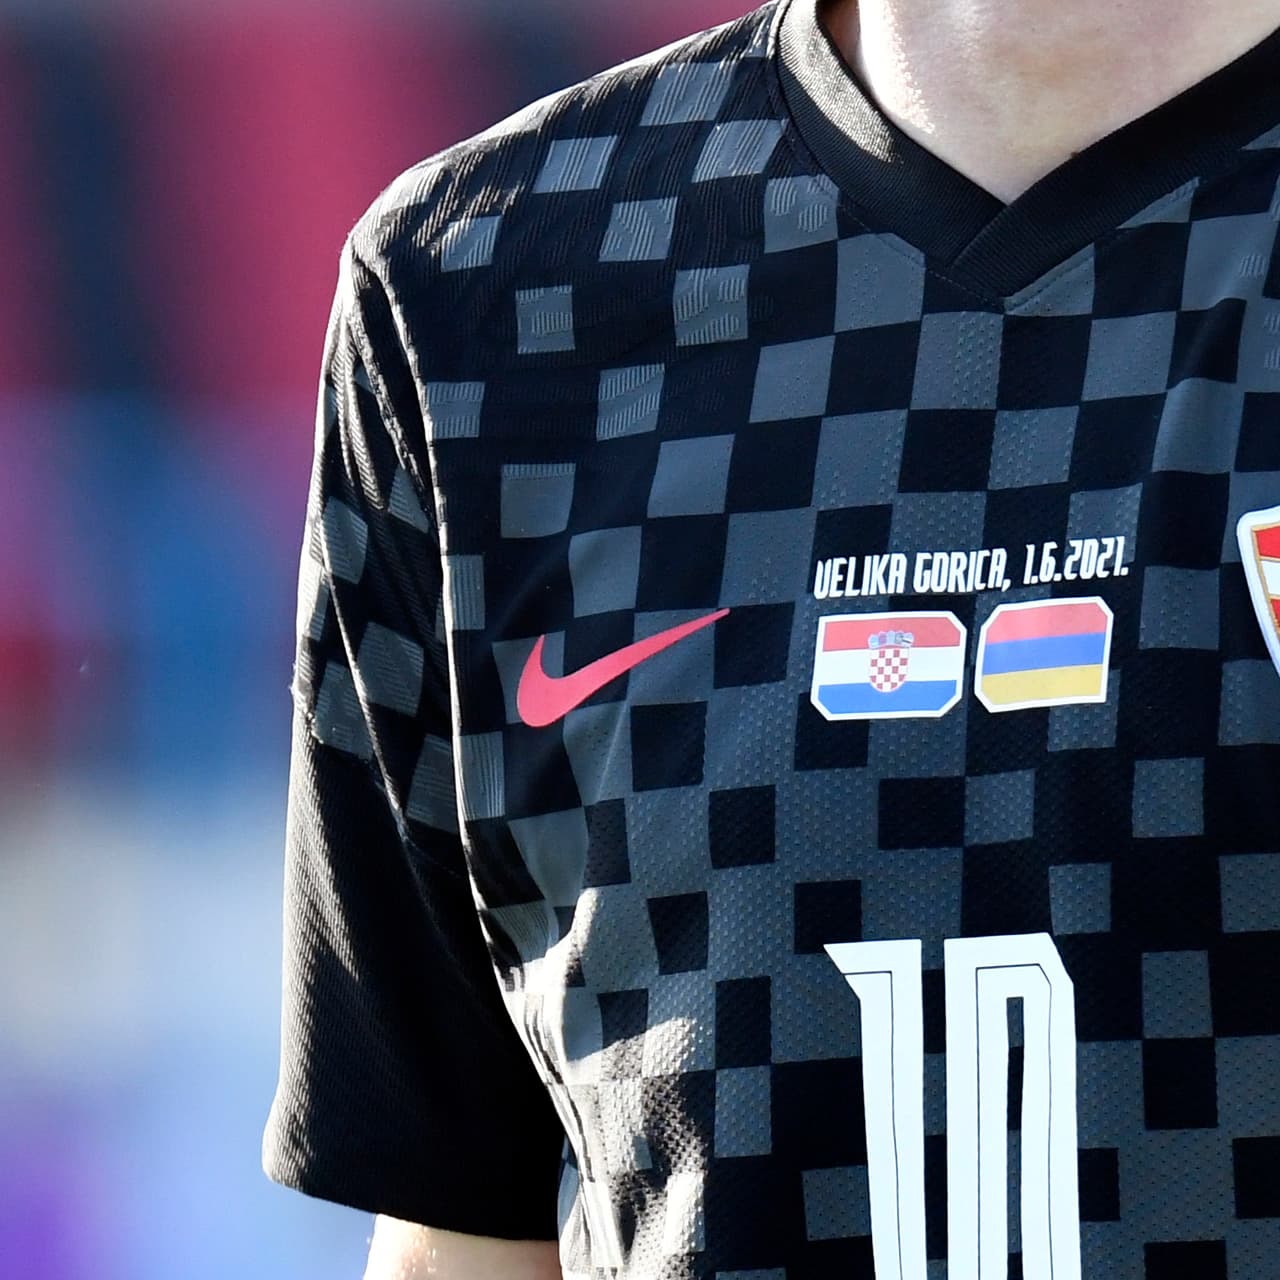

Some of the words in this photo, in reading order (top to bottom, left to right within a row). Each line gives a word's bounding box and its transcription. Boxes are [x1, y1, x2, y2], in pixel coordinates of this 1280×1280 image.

[814, 553, 907, 599] VELIKA
[913, 548, 1012, 592] GORICA,
[1023, 535, 1129, 584] 1.6.2021.
